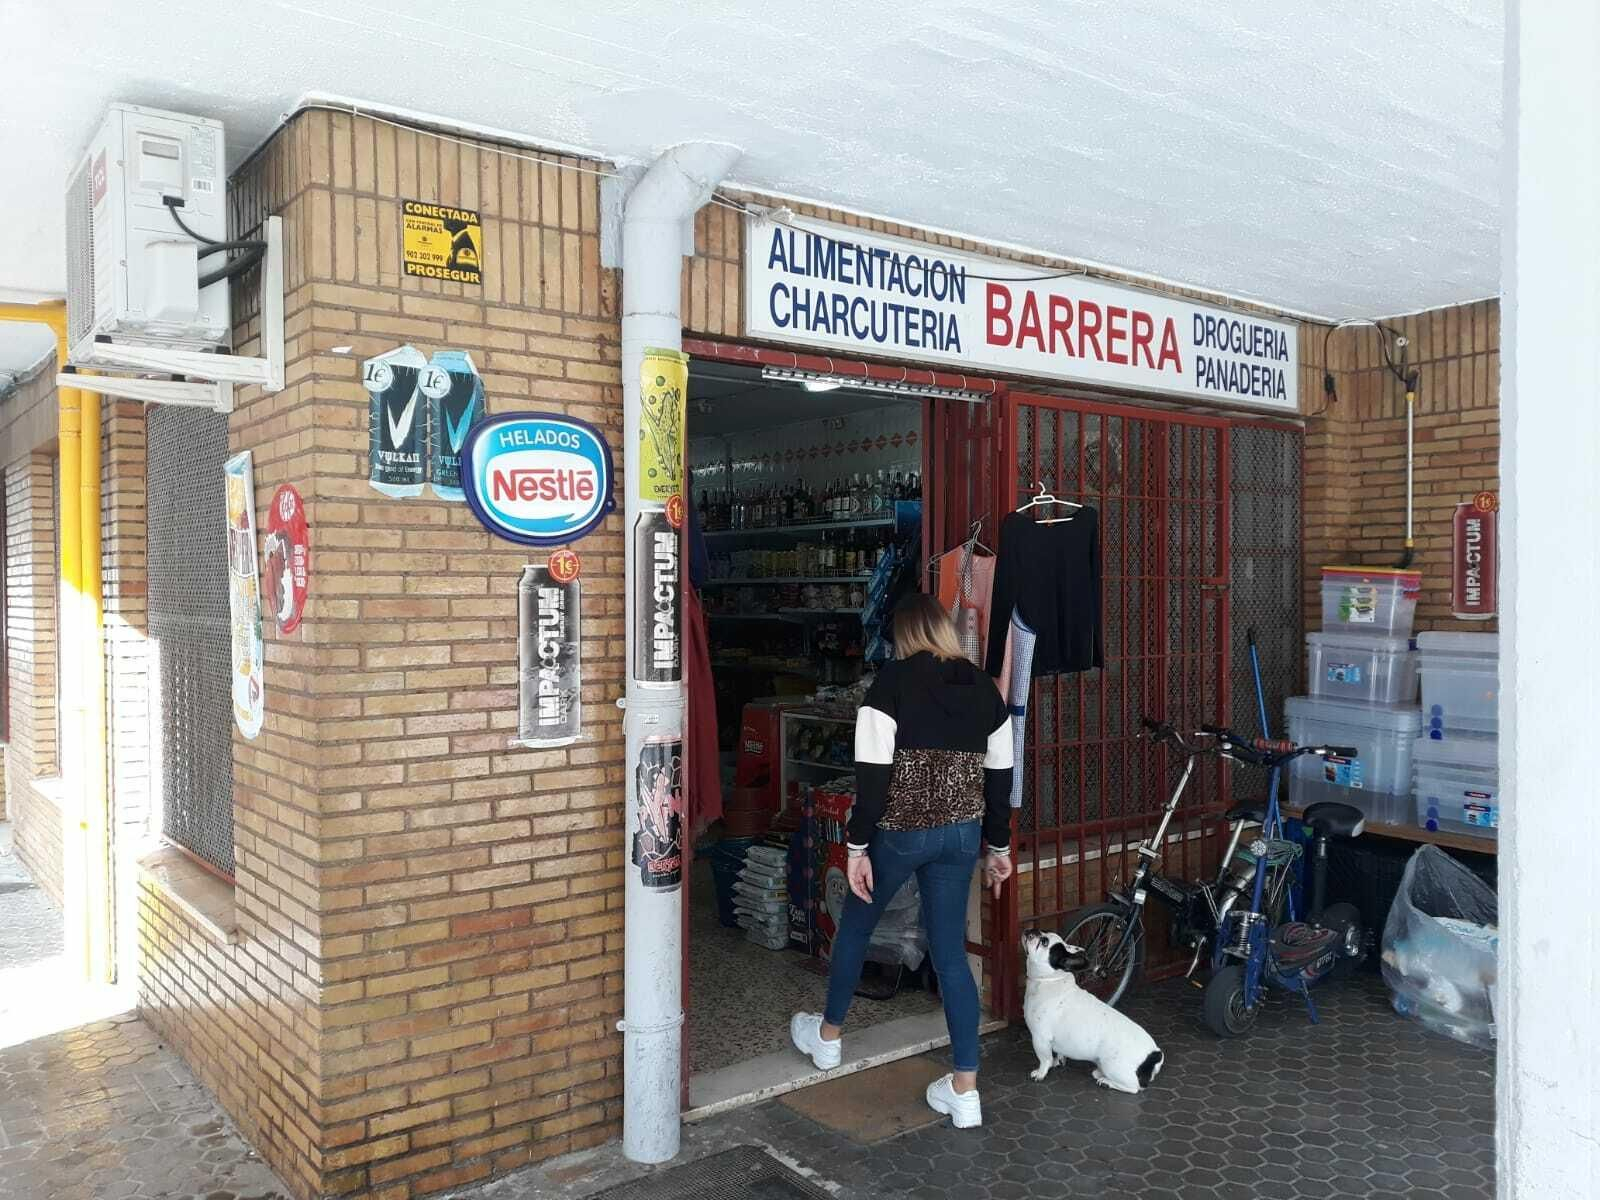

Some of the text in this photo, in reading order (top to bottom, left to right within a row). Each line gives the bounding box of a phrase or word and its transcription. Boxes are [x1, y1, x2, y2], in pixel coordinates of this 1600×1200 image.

[405, 202, 478, 223] CONECTADA
[406, 223, 443, 234] ALARMAS
[407, 263, 480, 283] PROSEGUR
[768, 227, 965, 304] ALIMENTACION
[769, 282, 961, 353] CHARCUTERIA
[986, 282, 1182, 373] BARRERA
[1193, 312, 1289, 361] DROGUERIA
[363, 363, 386, 384] 1€
[1196, 355, 1287, 400] PANADERIA
[499, 429, 580, 449] HELADOS
[492, 469, 594, 501] Nestlé
[556, 555, 573, 575] 1€
[1466, 518, 1481, 605] IMPACTUM
[654, 531, 675, 669] IMPACTUM
[538, 587, 561, 726] IMPACTUM
